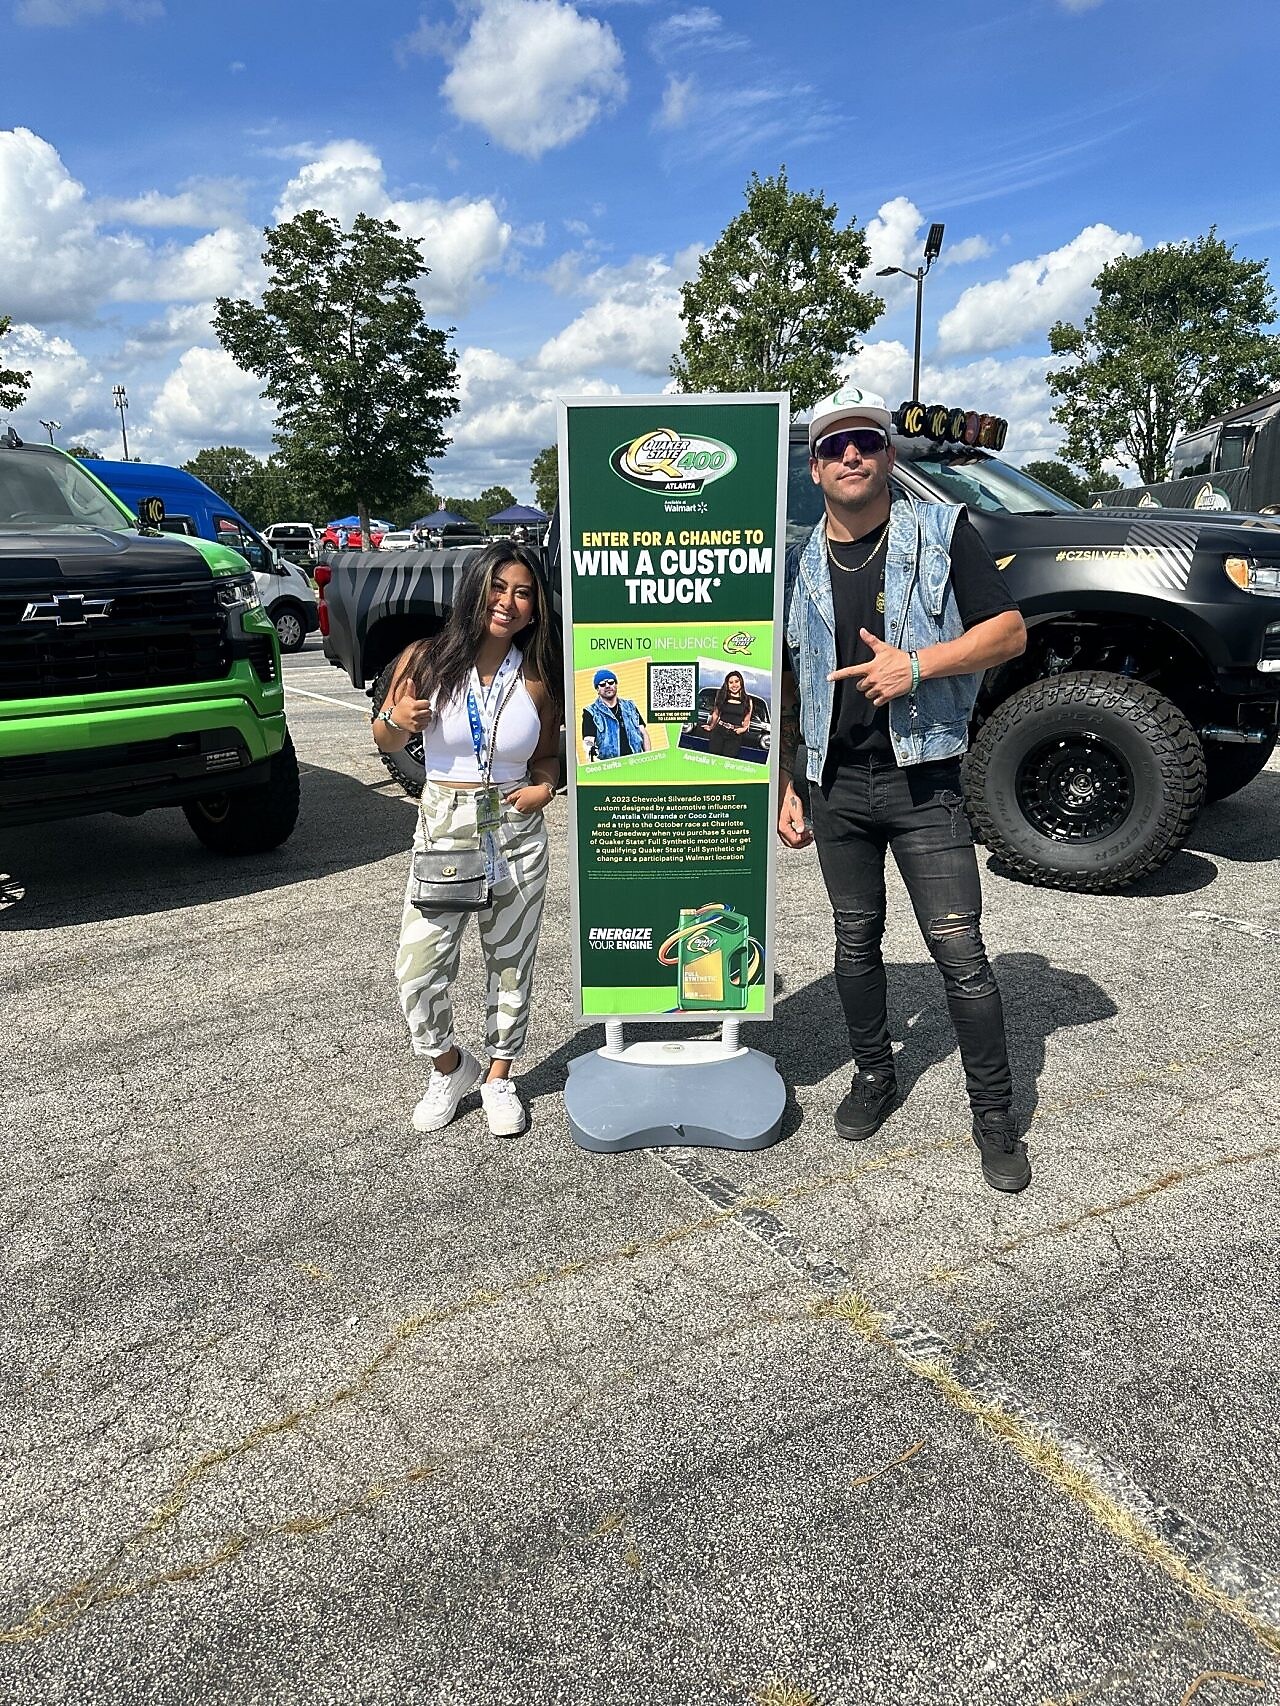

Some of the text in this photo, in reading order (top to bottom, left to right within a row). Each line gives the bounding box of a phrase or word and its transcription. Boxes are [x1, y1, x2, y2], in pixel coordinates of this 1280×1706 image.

[904, 405, 924, 434] KC
[931, 410, 950, 438] KC
[642, 440, 690, 451] QUAKER
[647, 450, 682, 459] STATE
[677, 450, 727, 470] 400
[664, 482, 696, 490] ATLANTA
[148, 499, 163, 522] KC
[664, 504, 697, 512] Walmart
[582, 529, 764, 547] ENTER FOR A CHANCE TO
[572, 547, 773, 576] WIN A CUSTOM
[590, 636, 719, 650] DRIVEN TO INFLUENCE
[683, 752, 710, 765] Anatalia
[585, 765, 602, 774] Coco
[602, 761, 622, 770] Zurita
[722, 794, 736, 802] RST
[613, 830, 650, 838] Speedway
[686, 829, 720, 837] purchase
[662, 838, 696, 846] Synthetic
[601, 847, 637, 855] qualifying
[638, 846, 664, 854] Quaker
[596, 855, 623, 863] change
[638, 855, 684, 863] participating
[588, 927, 653, 940] ENERGIZE
[588, 940, 653, 950] YOUR ENGINE
